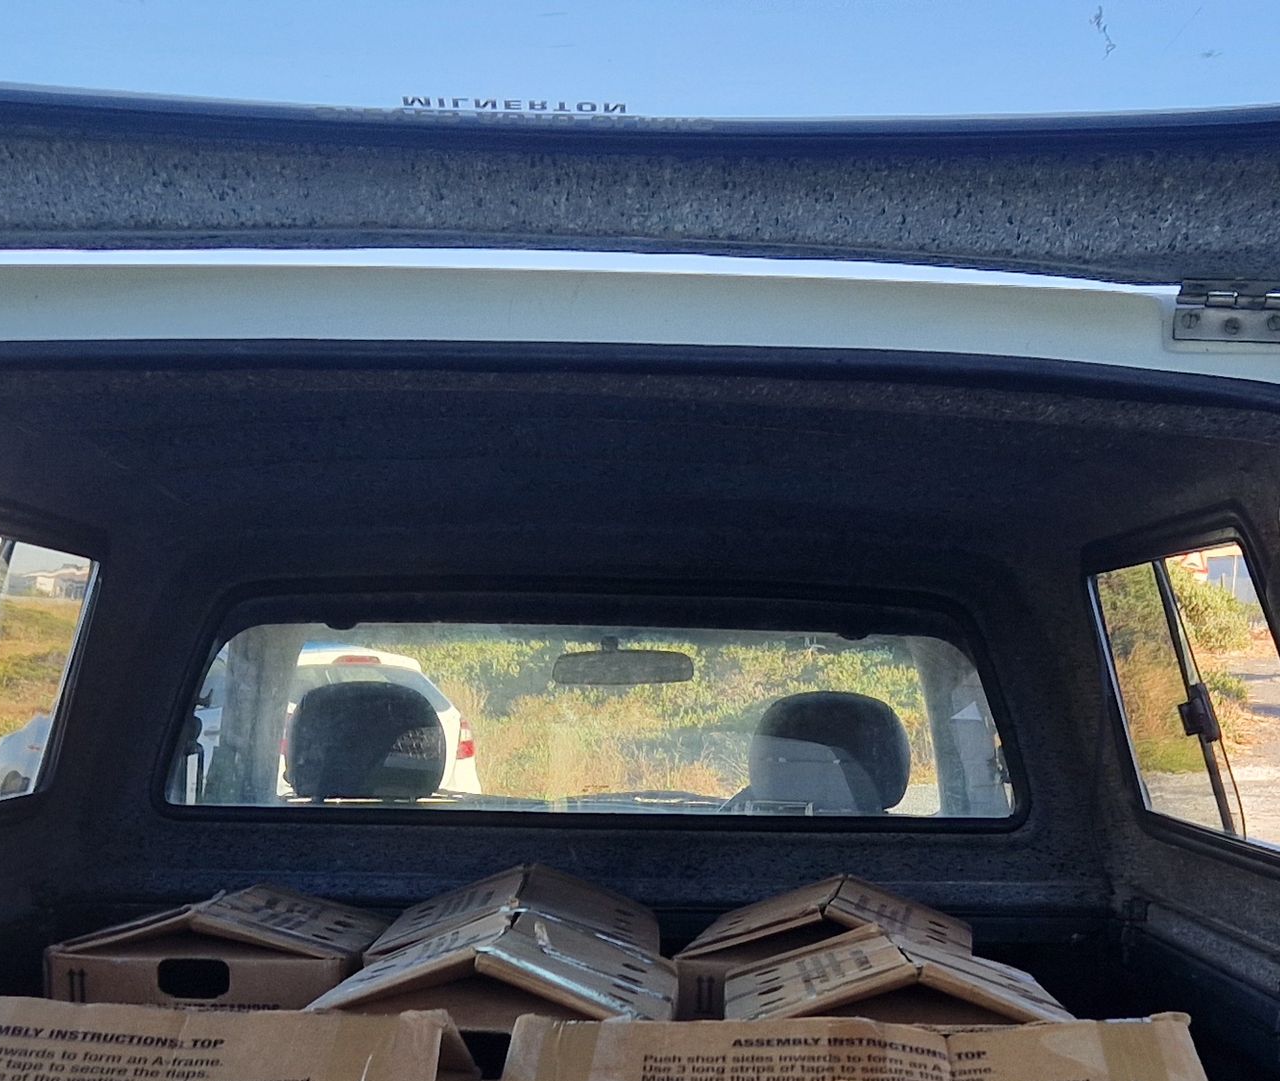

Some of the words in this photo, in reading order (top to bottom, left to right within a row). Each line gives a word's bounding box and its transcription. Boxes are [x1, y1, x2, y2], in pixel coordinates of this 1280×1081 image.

[191, 1038, 225, 1048] TOP
[732, 1037, 821, 1048] ASSEMBLY
[956, 1050, 987, 1060] TOP
[61, 1051, 76, 1061] to
[82, 1052, 122, 1063] form
[126, 1055, 148, 1064] an
[643, 1054, 681, 1064] Push
[687, 1054, 726, 1064] short
[732, 1054, 773, 1064] sides
[779, 1054, 841, 1064] inwards
[846, 1054, 862, 1064] to
[867, 1054, 903, 1067] form
[908, 1061, 927, 1070] an
[6, 1059, 43, 1072] tape
[48, 1062, 65, 1073] to
[70, 1065, 128, 1076] secure
[133, 1067, 160, 1078] the
[642, 1064, 672, 1074] Use
[676, 1065, 686, 1074] 3
[691, 1065, 726, 1076] long
[730, 1064, 774, 1076] strips
[780, 1064, 795, 1074] of
[800, 1065, 835, 1076] tape
[840, 1065, 856, 1074] to
[861, 1065, 914, 1078] secure
[919, 1071, 944, 1081] the
